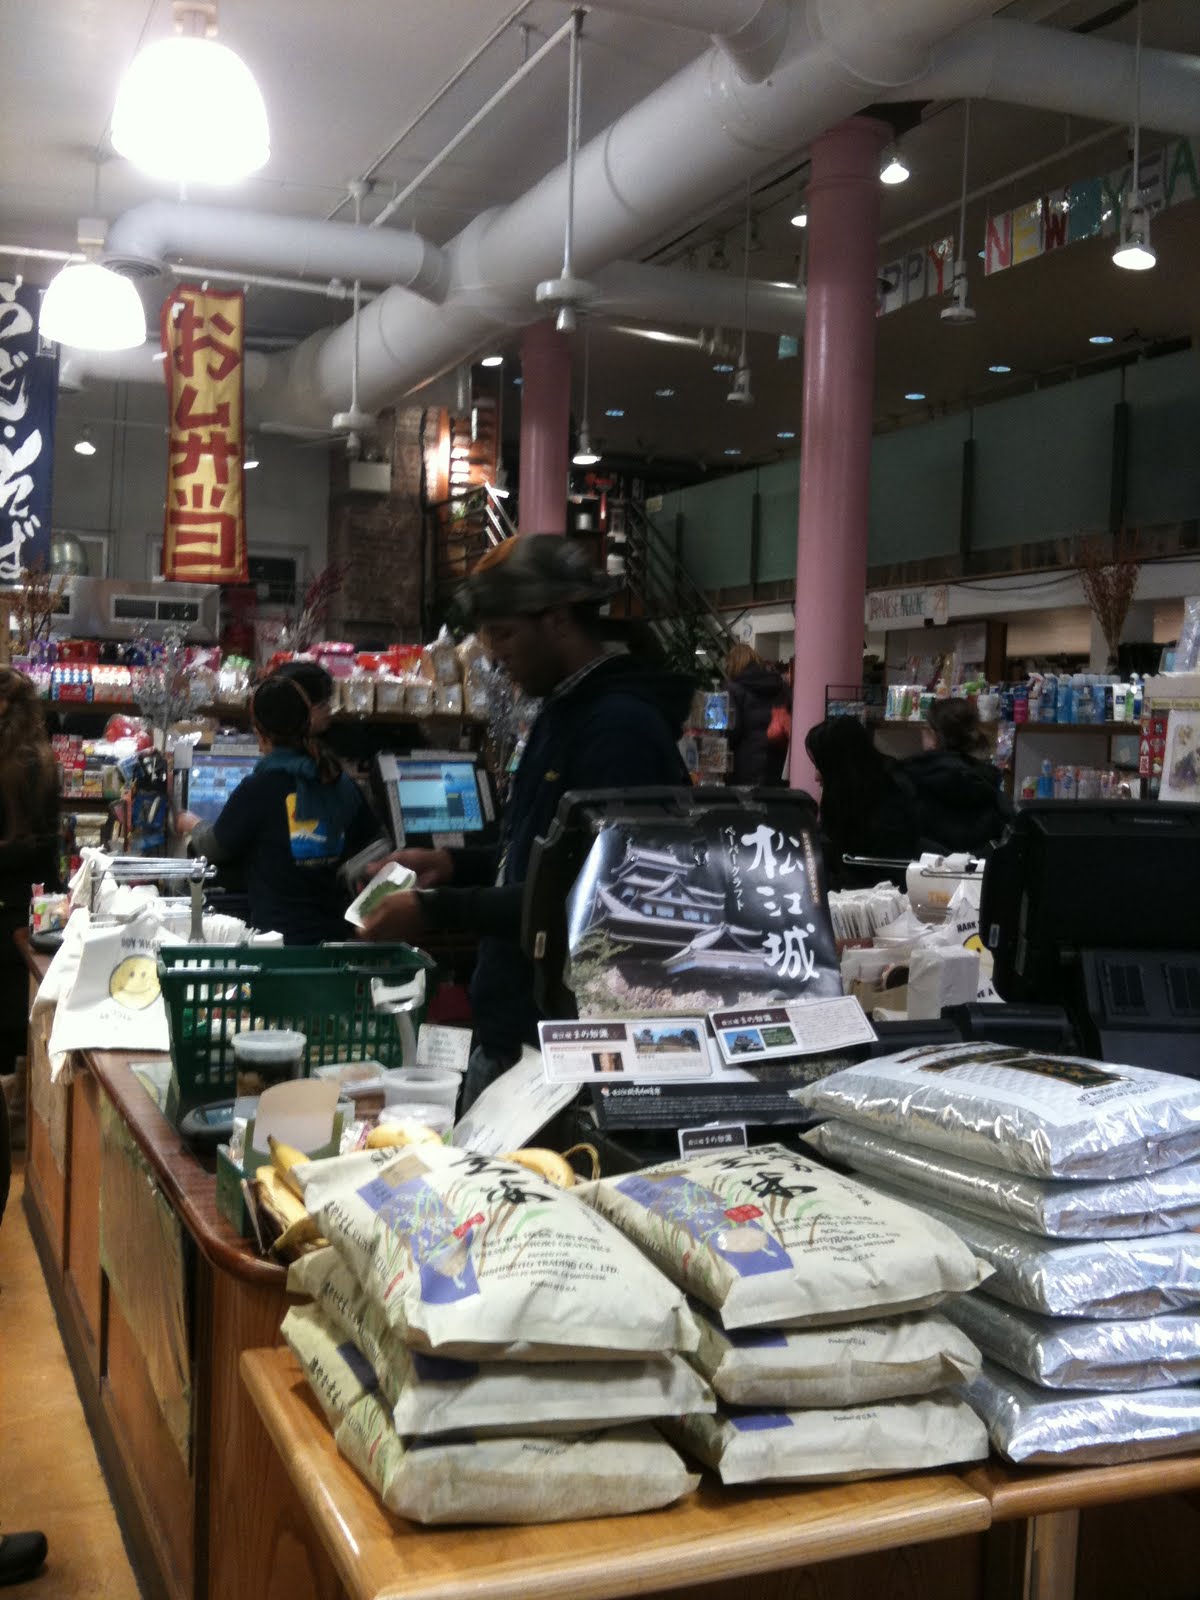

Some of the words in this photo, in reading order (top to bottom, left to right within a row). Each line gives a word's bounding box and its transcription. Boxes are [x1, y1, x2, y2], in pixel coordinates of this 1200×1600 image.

[986, 187, 1070, 274] NEW
[171, 300, 241, 569] お弁当
[741, 825, 820, 982] 松江城
